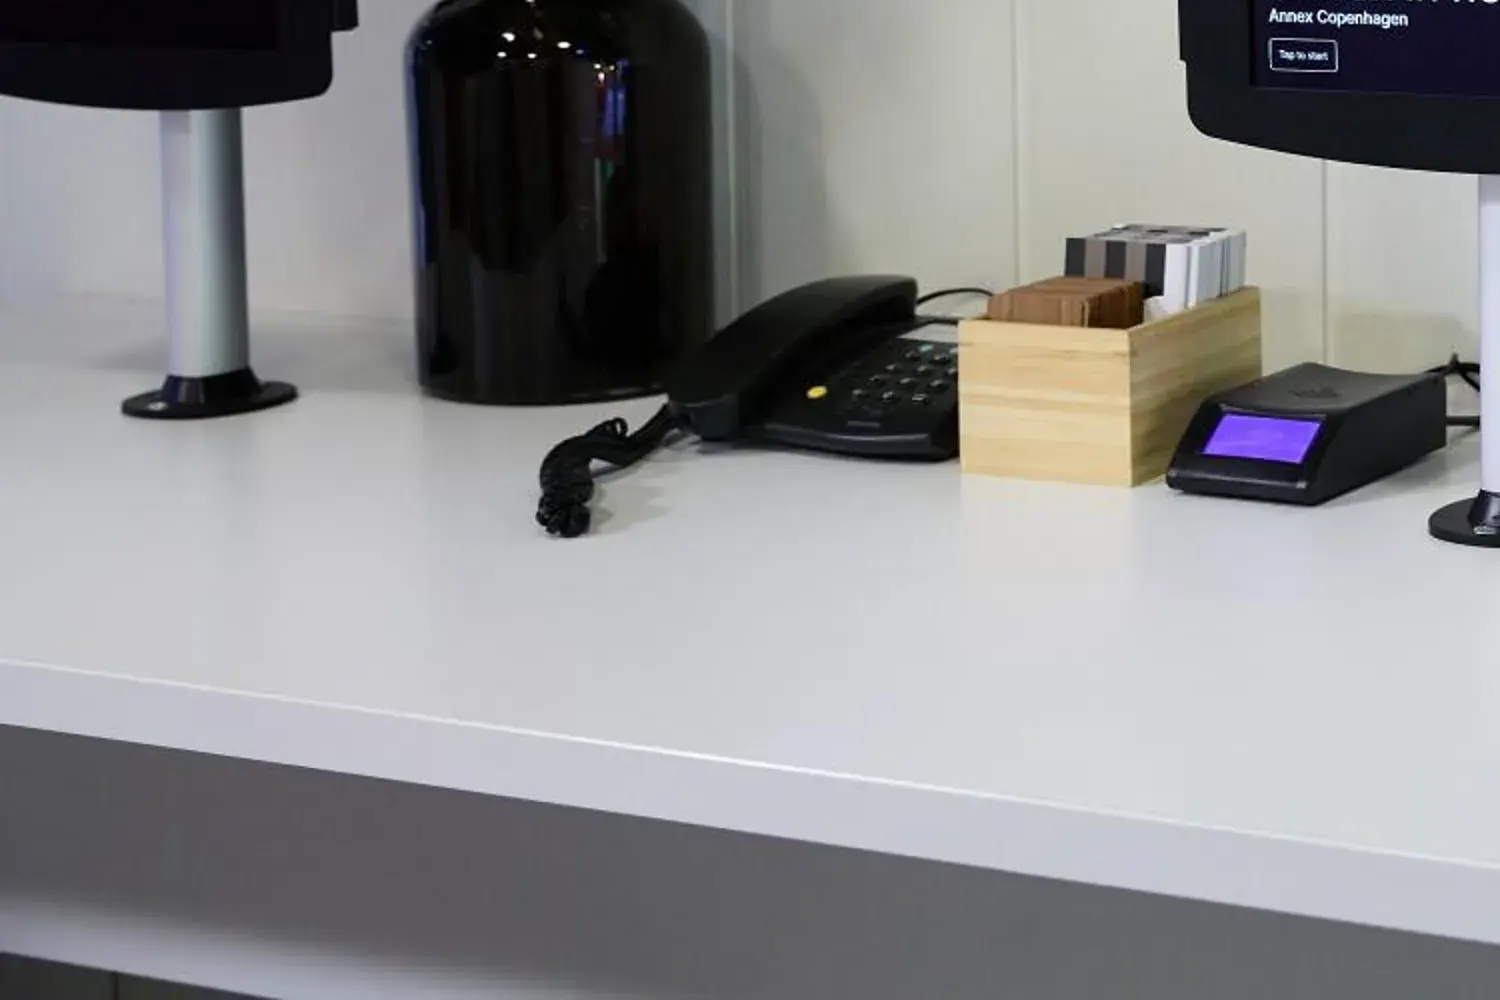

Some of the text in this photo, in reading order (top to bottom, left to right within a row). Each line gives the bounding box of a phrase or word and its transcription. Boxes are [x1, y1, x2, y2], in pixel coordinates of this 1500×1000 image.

[1268, 7, 1409, 29] Annex Copenhagen
[1278, 49, 1294, 62] Tap
[1307, 51, 1329, 62] start
